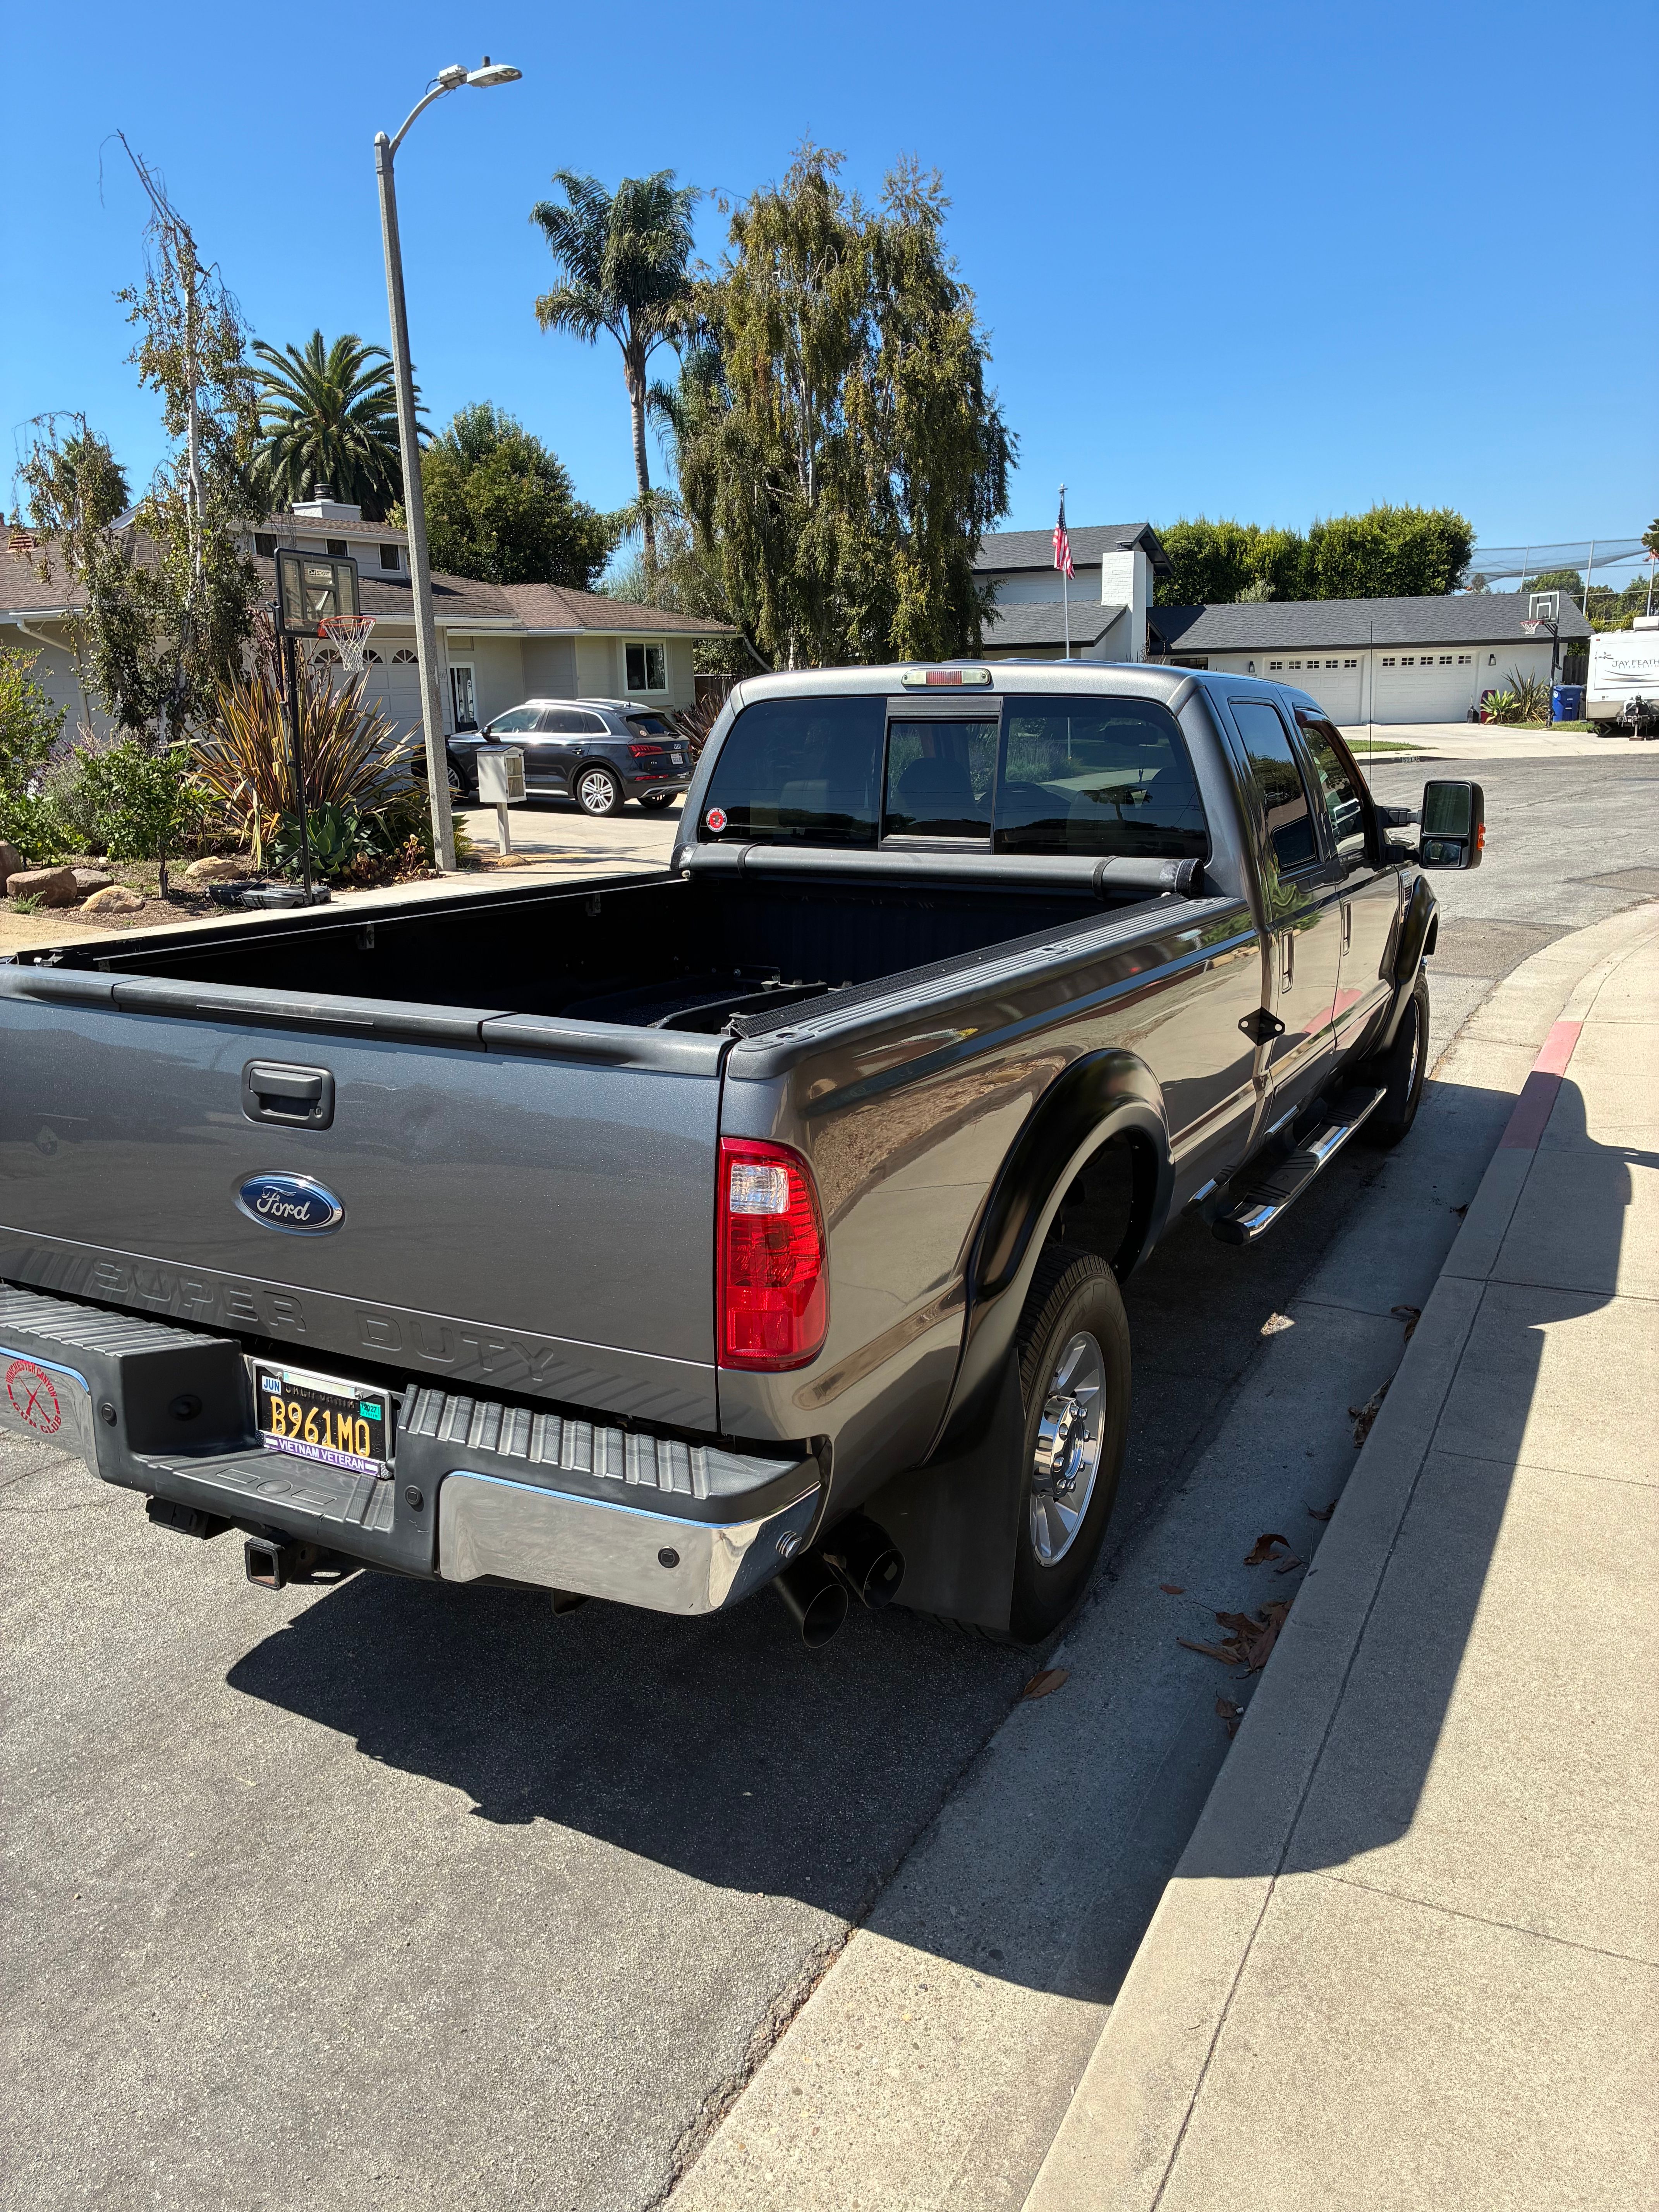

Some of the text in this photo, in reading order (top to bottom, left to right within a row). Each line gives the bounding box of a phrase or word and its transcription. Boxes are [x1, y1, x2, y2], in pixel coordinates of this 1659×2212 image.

[256, 1186, 311, 1221] Ford
[93, 1258, 554, 1381] SUPER DUTY
[6, 1360, 57, 1397] WINCHESTER CANYON
[264, 1378, 280, 1392] JUN
[12, 1402, 62, 1433] GUN CLUB
[278, 1439, 364, 1470] VIETNAM VETERAN
